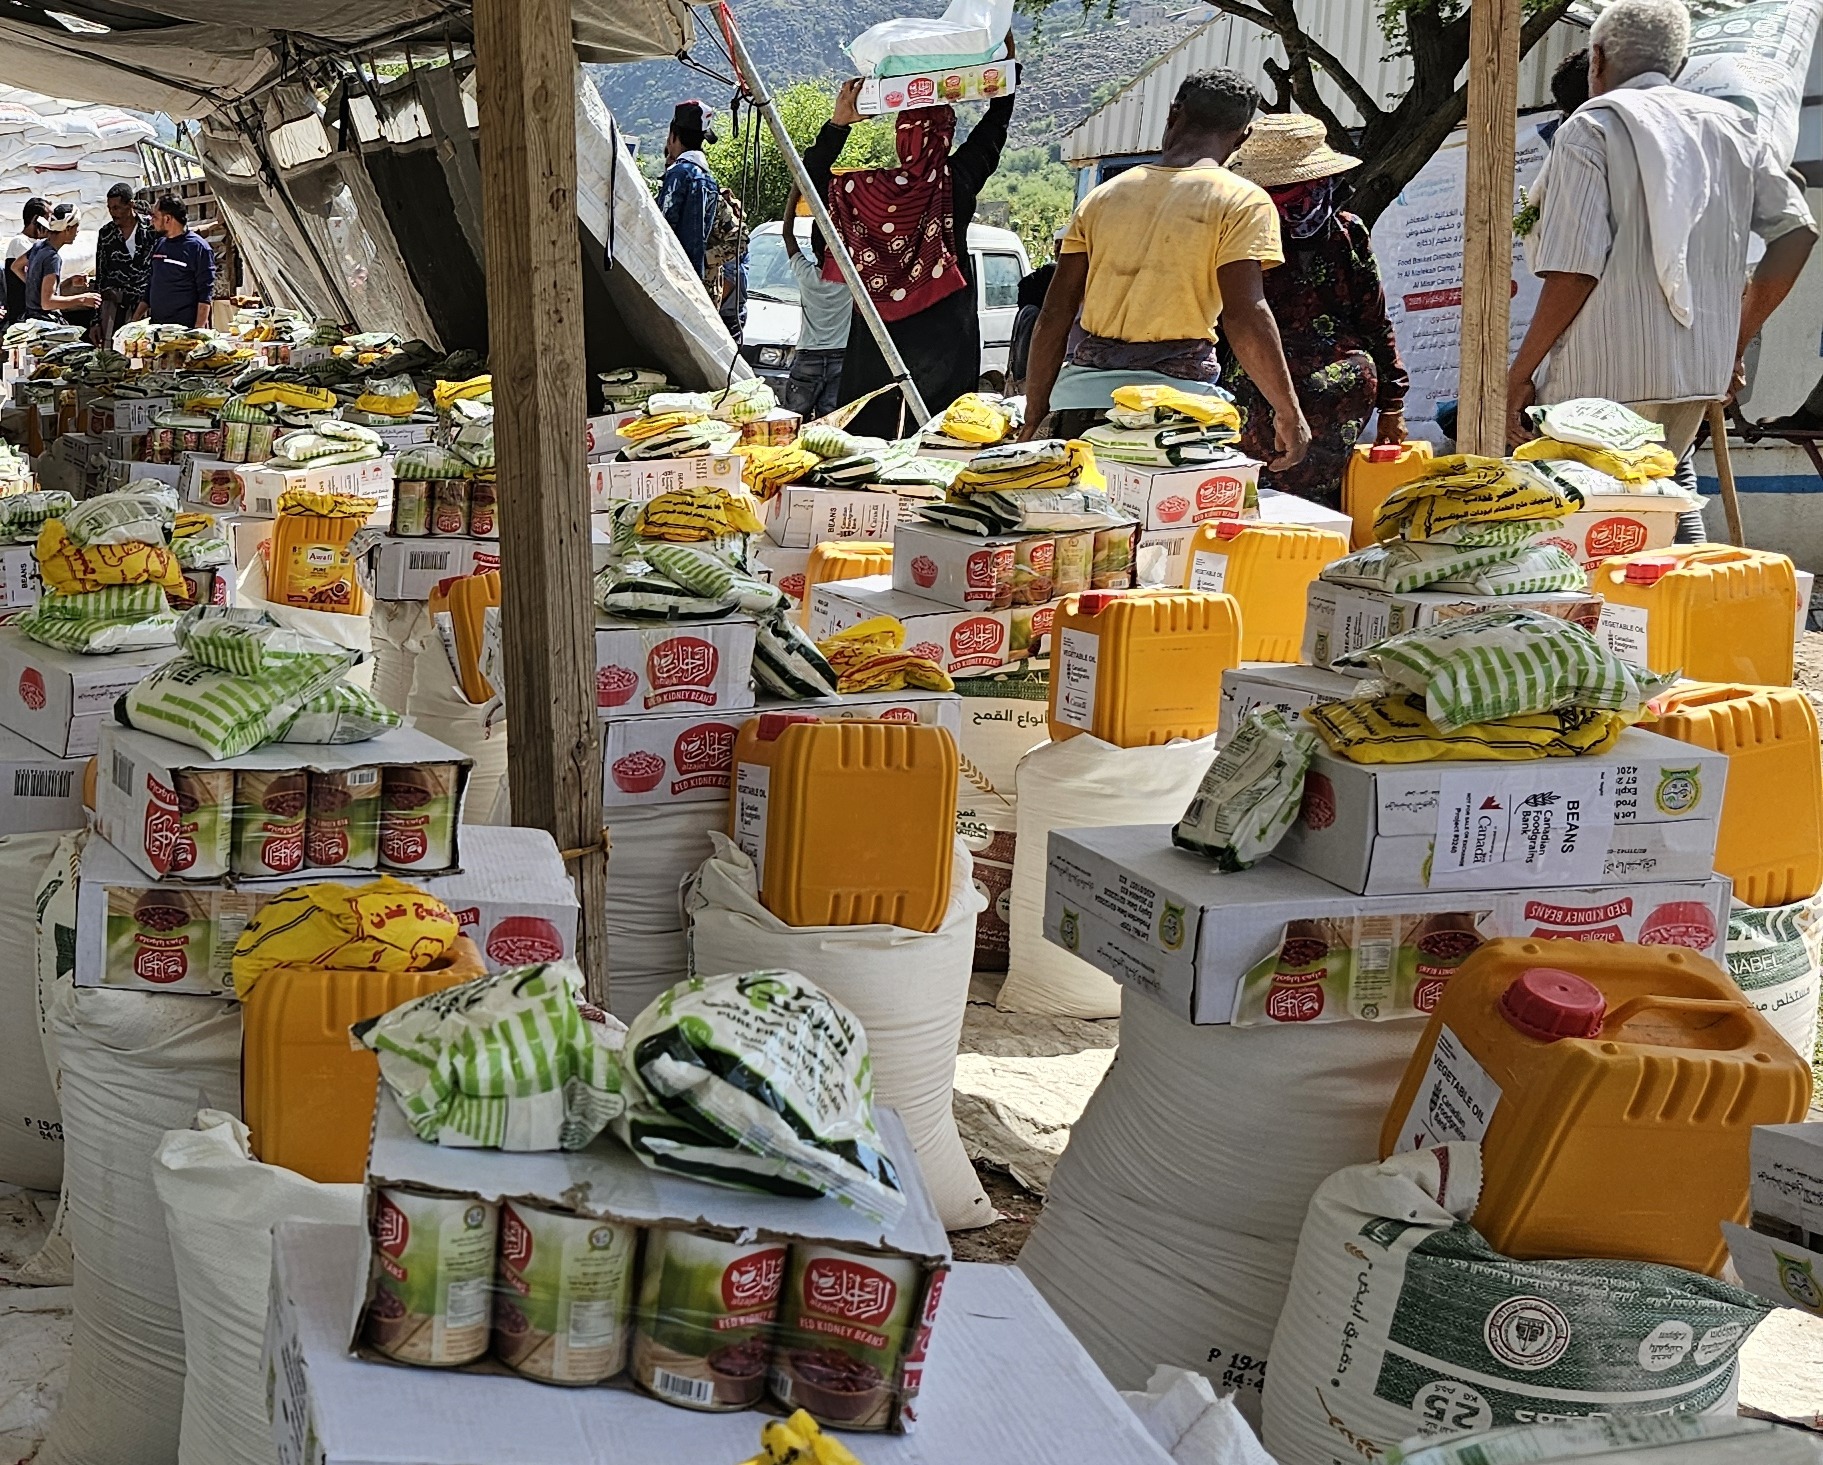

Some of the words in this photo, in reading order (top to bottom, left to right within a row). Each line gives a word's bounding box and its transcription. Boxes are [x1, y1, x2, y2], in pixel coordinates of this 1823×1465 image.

[1515, 147, 1539, 156] nadian
[1515, 155, 1544, 165] odgrains
[1433, 250, 1463, 262] Distributio
[20, 563, 28, 589] BEANS
[1601, 619, 1634, 632] VEGETABLE
[1635, 625, 1645, 634] OIL
[1063, 649, 1088, 662] VEGETABLE
[663, 690, 690, 702] KIDNEY
[691, 691, 714, 703] BEANS
[972, 709, 1013, 725] القمح
[1616, 766, 1637, 775] 420
[674, 779, 689, 791] RED
[690, 776, 717, 788] KIDNEY
[717, 776, 730, 785] BEA
[1615, 786, 1638, 796] Expi
[1615, 798, 1637, 808] Prod
[1452, 807, 1462, 833] Project
[1520, 810, 1532, 835] Bank
[1620, 810, 1636, 820] Lot
[1538, 809, 1554, 856] Canadian
[1560, 799, 1579, 854] BEANS
[1472, 815, 1492, 865] Canada
[1525, 810, 1543, 864] Foodgrains
[1529, 904, 1562, 922] BEANS
[1564, 907, 1604, 924] KIDNEY
[1607, 902, 1628, 917] RED
[1771, 987, 1811, 1012] مستخلص
[717, 1010, 753, 1031] PURE
[1433, 1053, 1474, 1109] VEGETABLE
[1471, 1103, 1484, 1125] OIL
[1441, 1094, 1466, 1128] Canadian
[24, 1117, 32, 1127] P
[1433, 1111, 1448, 1132] Bank
[1437, 1102, 1466, 1142] Foodgrains
[1608, 1274, 1642, 1289] YEMEN
[718, 1317, 738, 1329] RED
[816, 1320, 853, 1337] KIDNEY
[853, 1329, 886, 1347] BEANS
[1206, 1348, 1222, 1363] P
[1337, 1321, 1360, 1374] دقيق
[1433, 1383, 1456, 1396] كجم
[1463, 1392, 1479, 1404] KG
[1422, 1393, 1481, 1431] 25
